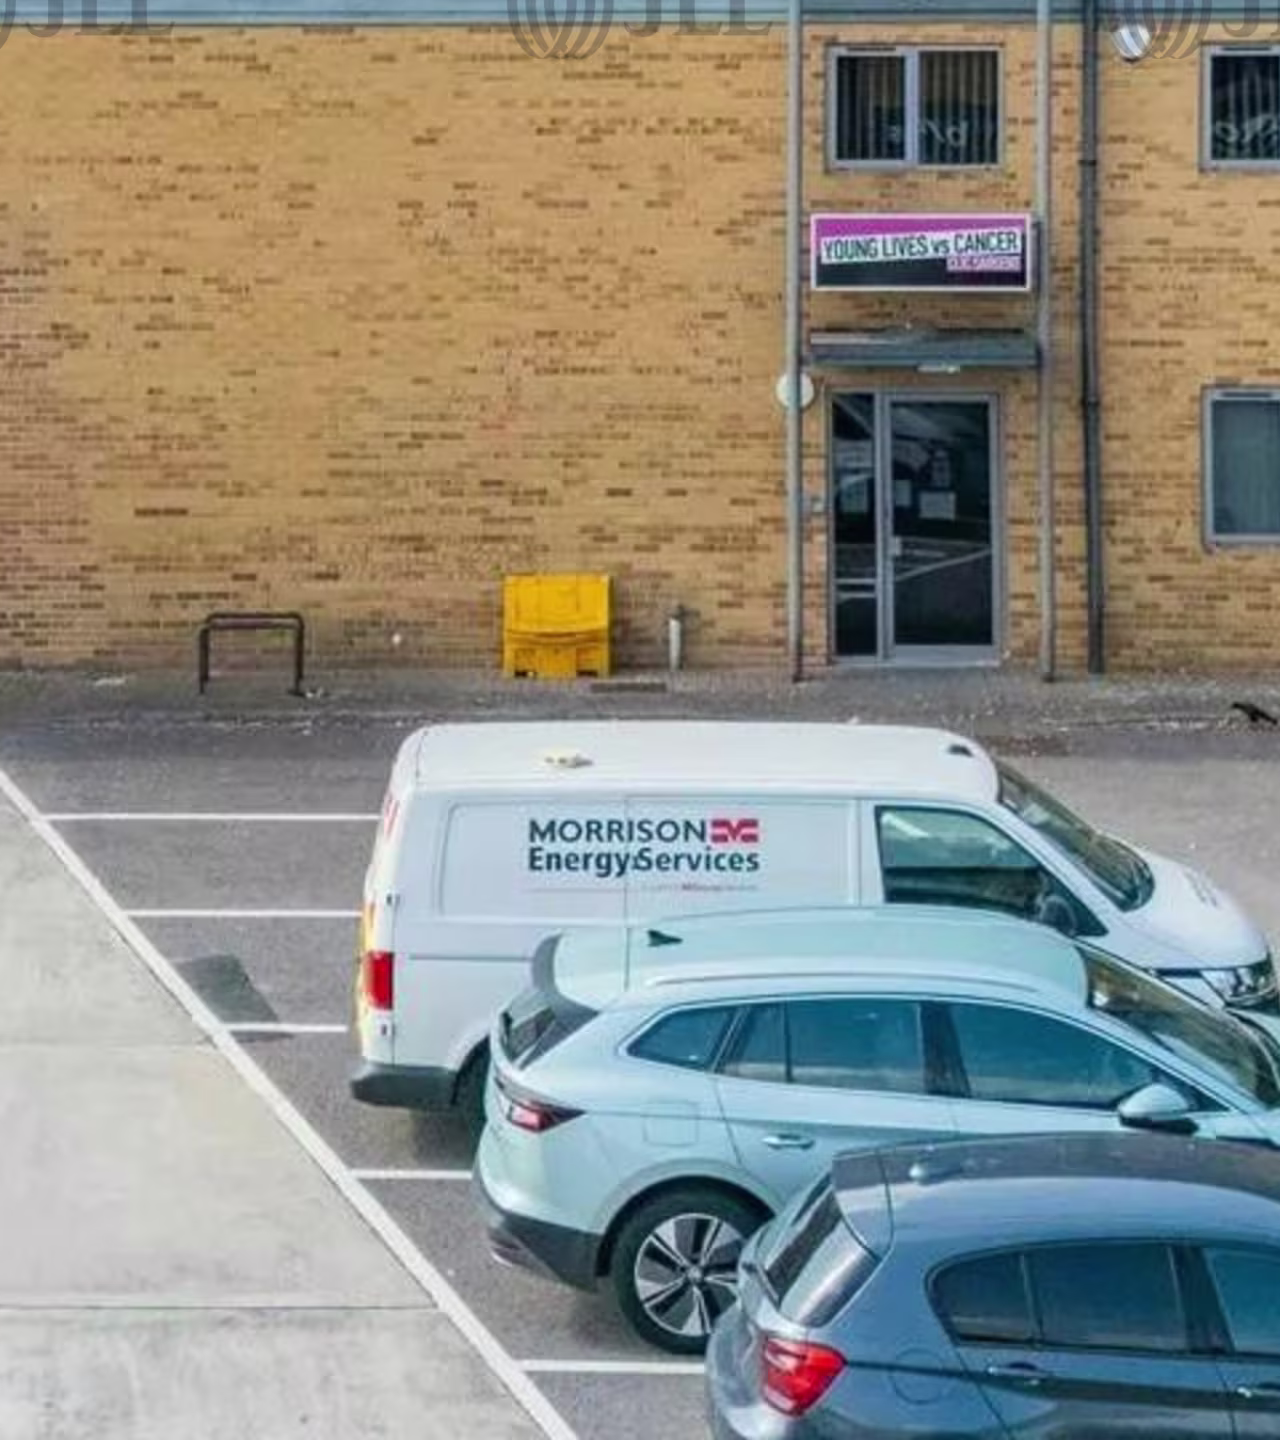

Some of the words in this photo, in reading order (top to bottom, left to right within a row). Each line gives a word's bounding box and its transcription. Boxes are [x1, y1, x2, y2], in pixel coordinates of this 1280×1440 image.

[823, 238, 878, 259] YOUNG
[882, 235, 929, 257] LIVES
[932, 239, 950, 254] vs
[953, 231, 1018, 254] CANCER
[529, 818, 707, 843] MORRISON
